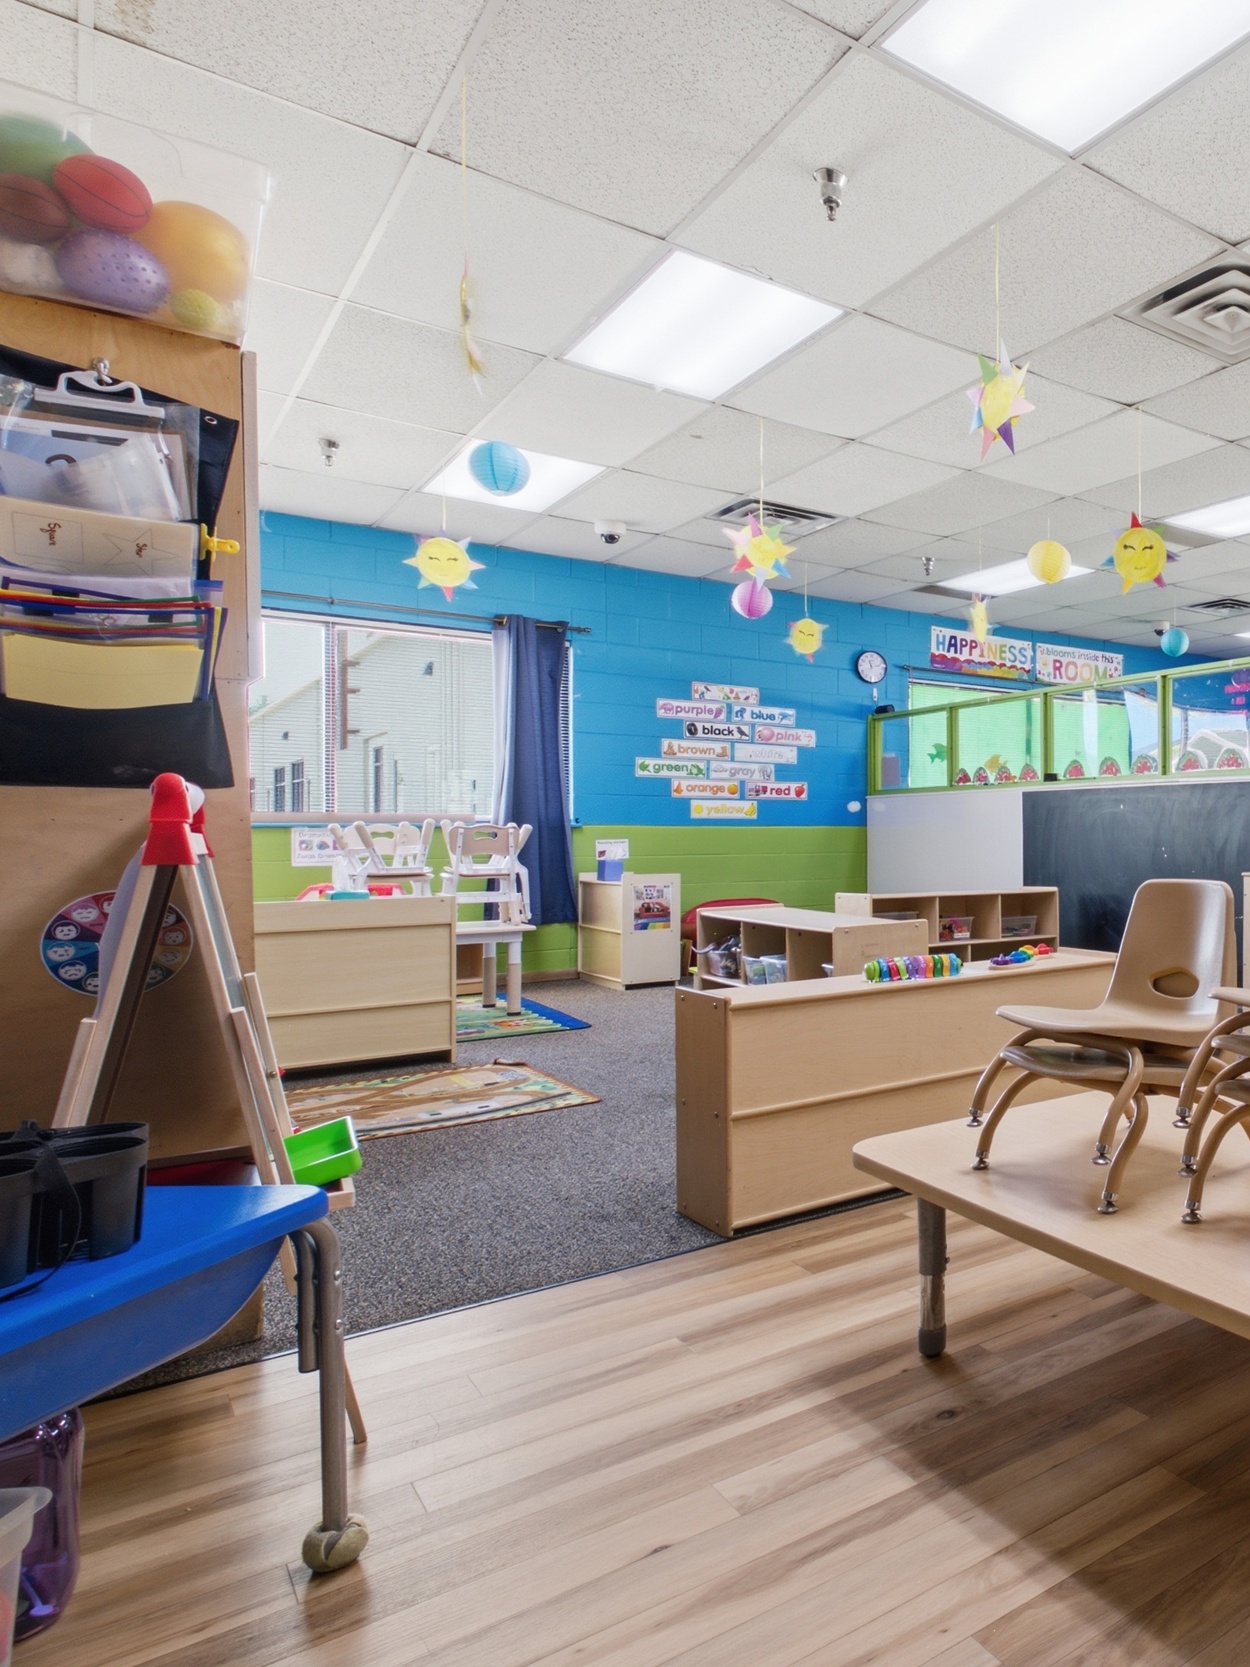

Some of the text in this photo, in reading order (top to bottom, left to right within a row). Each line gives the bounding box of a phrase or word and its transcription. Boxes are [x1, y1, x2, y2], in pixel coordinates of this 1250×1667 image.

[936, 633, 1028, 665] HAPPINESS
[1046, 647, 1114, 664] blooms inside this
[1053, 658, 1108, 683] ROOM
[675, 703, 714, 717] purple
[750, 709, 776, 722] blue
[702, 724, 734, 737] black
[775, 731, 802, 743] pink
[677, 743, 716, 756] brown
[653, 762, 689, 774] green
[728, 765, 756, 779] gray
[686, 783, 725, 796] orange
[769, 785, 791, 796] red
[706, 803, 745, 816] yellow
